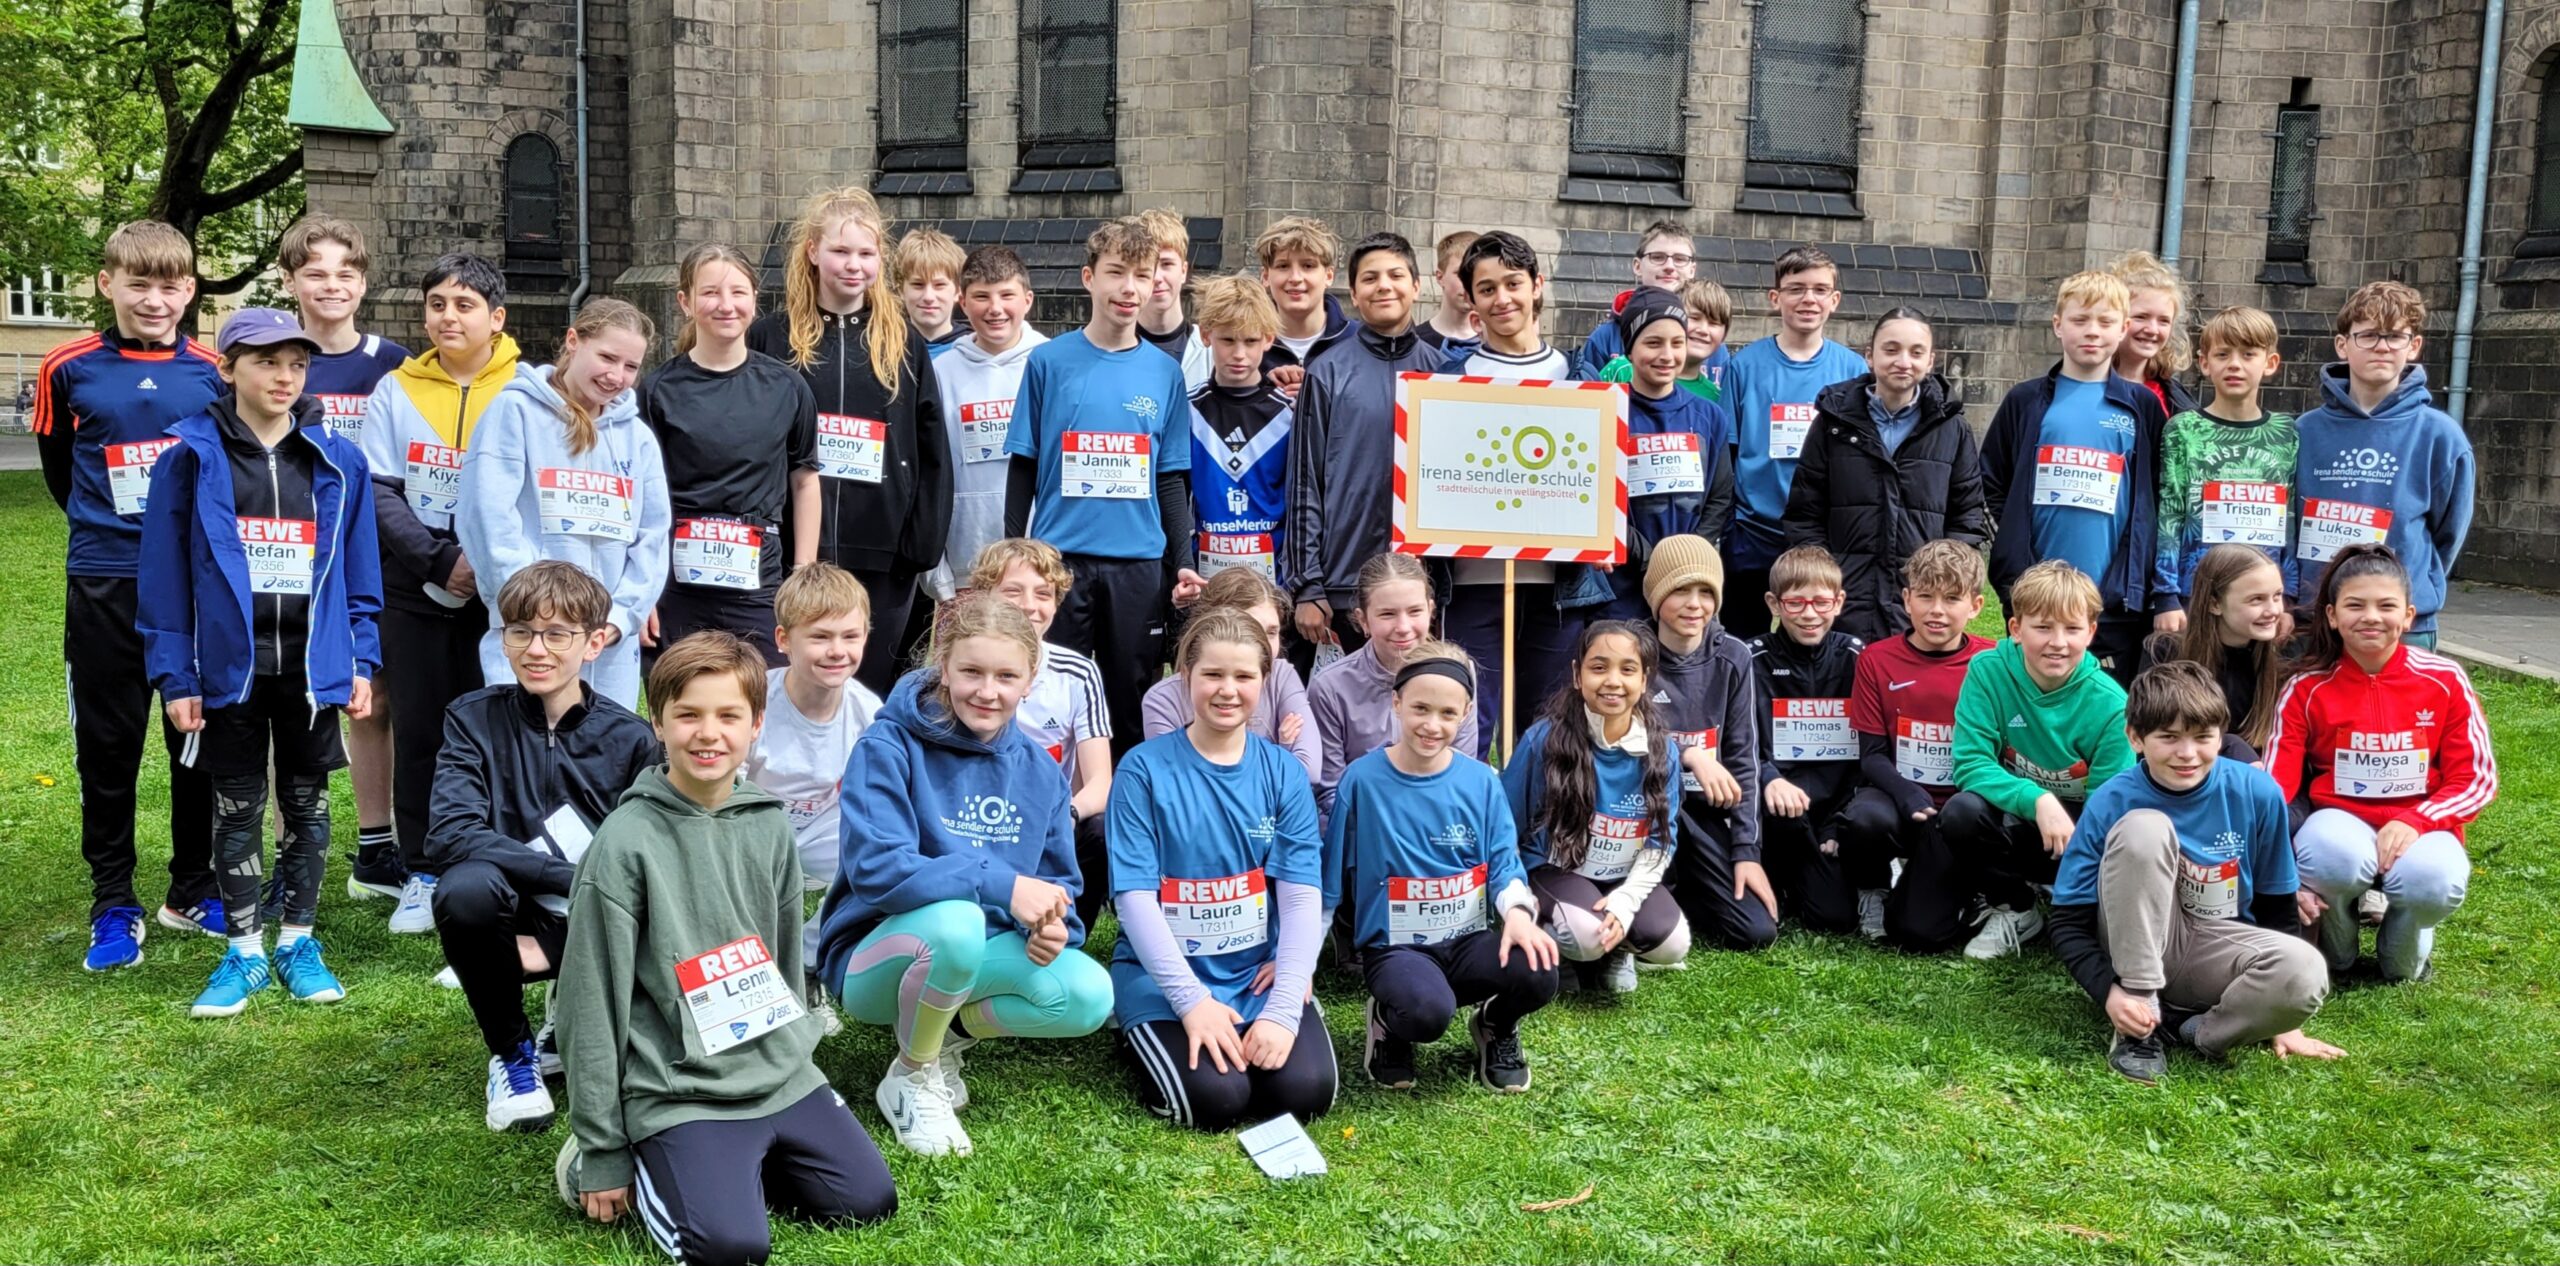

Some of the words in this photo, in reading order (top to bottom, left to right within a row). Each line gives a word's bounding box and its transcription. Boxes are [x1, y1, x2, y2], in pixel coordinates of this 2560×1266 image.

[322, 396, 368, 415] EWE
[973, 400, 1016, 420] REW
[321, 416, 365, 430] bias
[817, 415, 871, 438] REWE
[980, 420, 1011, 433] Sha
[819, 434, 864, 454] Leony
[1078, 434, 1136, 453] REWE
[1637, 434, 1689, 454] REWE
[423, 445, 467, 468] REW
[826, 449, 856, 461] 17360
[873, 453, 880, 463] C
[1081, 454, 1132, 468] Jannik
[1651, 454, 1682, 466] Eren
[2051, 448, 2110, 469] REWE
[2205, 445, 2240, 466] RISE
[848, 467, 870, 477] asics
[1093, 469, 1122, 479] 17333
[1140, 467, 1146, 478] C
[1421, 464, 1461, 481] irena
[1466, 469, 1526, 484] sendler
[1541, 472, 1592, 487] schule
[2053, 465, 2103, 482] Bennet
[2367, 470, 2395, 478] schule
[434, 482, 460, 495] 1735
[556, 471, 618, 494] REWE
[1116, 484, 1137, 494] asics
[2062, 479, 2091, 490] 17318
[2110, 484, 2116, 495] E
[1436, 484, 1502, 495] stadtteilschule
[1504, 487, 1513, 496] in
[1514, 488, 1577, 499] wellingsbüttel
[2219, 484, 2277, 502] REWE
[567, 491, 610, 508] Karla
[2083, 496, 2104, 507] asics
[573, 506, 606, 517] 17352
[2223, 503, 2271, 516] Tristan
[2315, 501, 2376, 525] REWE
[2235, 517, 2263, 527] 17313
[2278, 516, 2284, 527] E
[2318, 520, 2362, 537] Lukas
[236, 519, 303, 542] REWE
[600, 525, 622, 535] asics
[690, 521, 750, 544] REWE
[2256, 532, 2274, 542] asics
[703, 541, 735, 558] Lilly
[1209, 535, 1261, 554] REWE
[702, 556, 733, 568] 17368
[750, 559, 757, 570] C
[1266, 564, 1273, 575] C
[277, 578, 304, 589] asics
[725, 573, 746, 584] asics
[1787, 700, 1845, 716] REWE
[1792, 721, 1841, 732] Thomas
[1911, 721, 1952, 741] REW
[1802, 733, 1832, 742] 17342
[1850, 730, 1857, 740] D
[2350, 731, 2414, 750] REWE
[1826, 747, 1847, 756] asics
[2015, 752, 2073, 780] REWE
[2355, 753, 2409, 770] Meysa
[2418, 762, 2425, 773] D
[2366, 768, 2400, 778] 17343
[2393, 782, 2415, 792] asics
[1590, 814, 1639, 838] EWE
[1593, 838, 1622, 852] uba
[1591, 850, 1616, 862] 7341
[1178, 875, 1250, 902] REWE
[1407, 871, 1474, 899] REWE
[2227, 889, 2234, 899] D
[1419, 899, 1466, 915] Fenja
[1478, 898, 1484, 910] E
[1190, 904, 1242, 920] Laura
[1258, 908, 1264, 920] E
[2195, 907, 2223, 916] asics
[1199, 920, 1234, 933] 17311
[1427, 913, 1461, 927] 17316
[1230, 932, 1254, 947] asics
[699, 938, 766, 982] REWE
[722, 965, 772, 998] Lenni
[738, 986, 774, 1010] 17315
